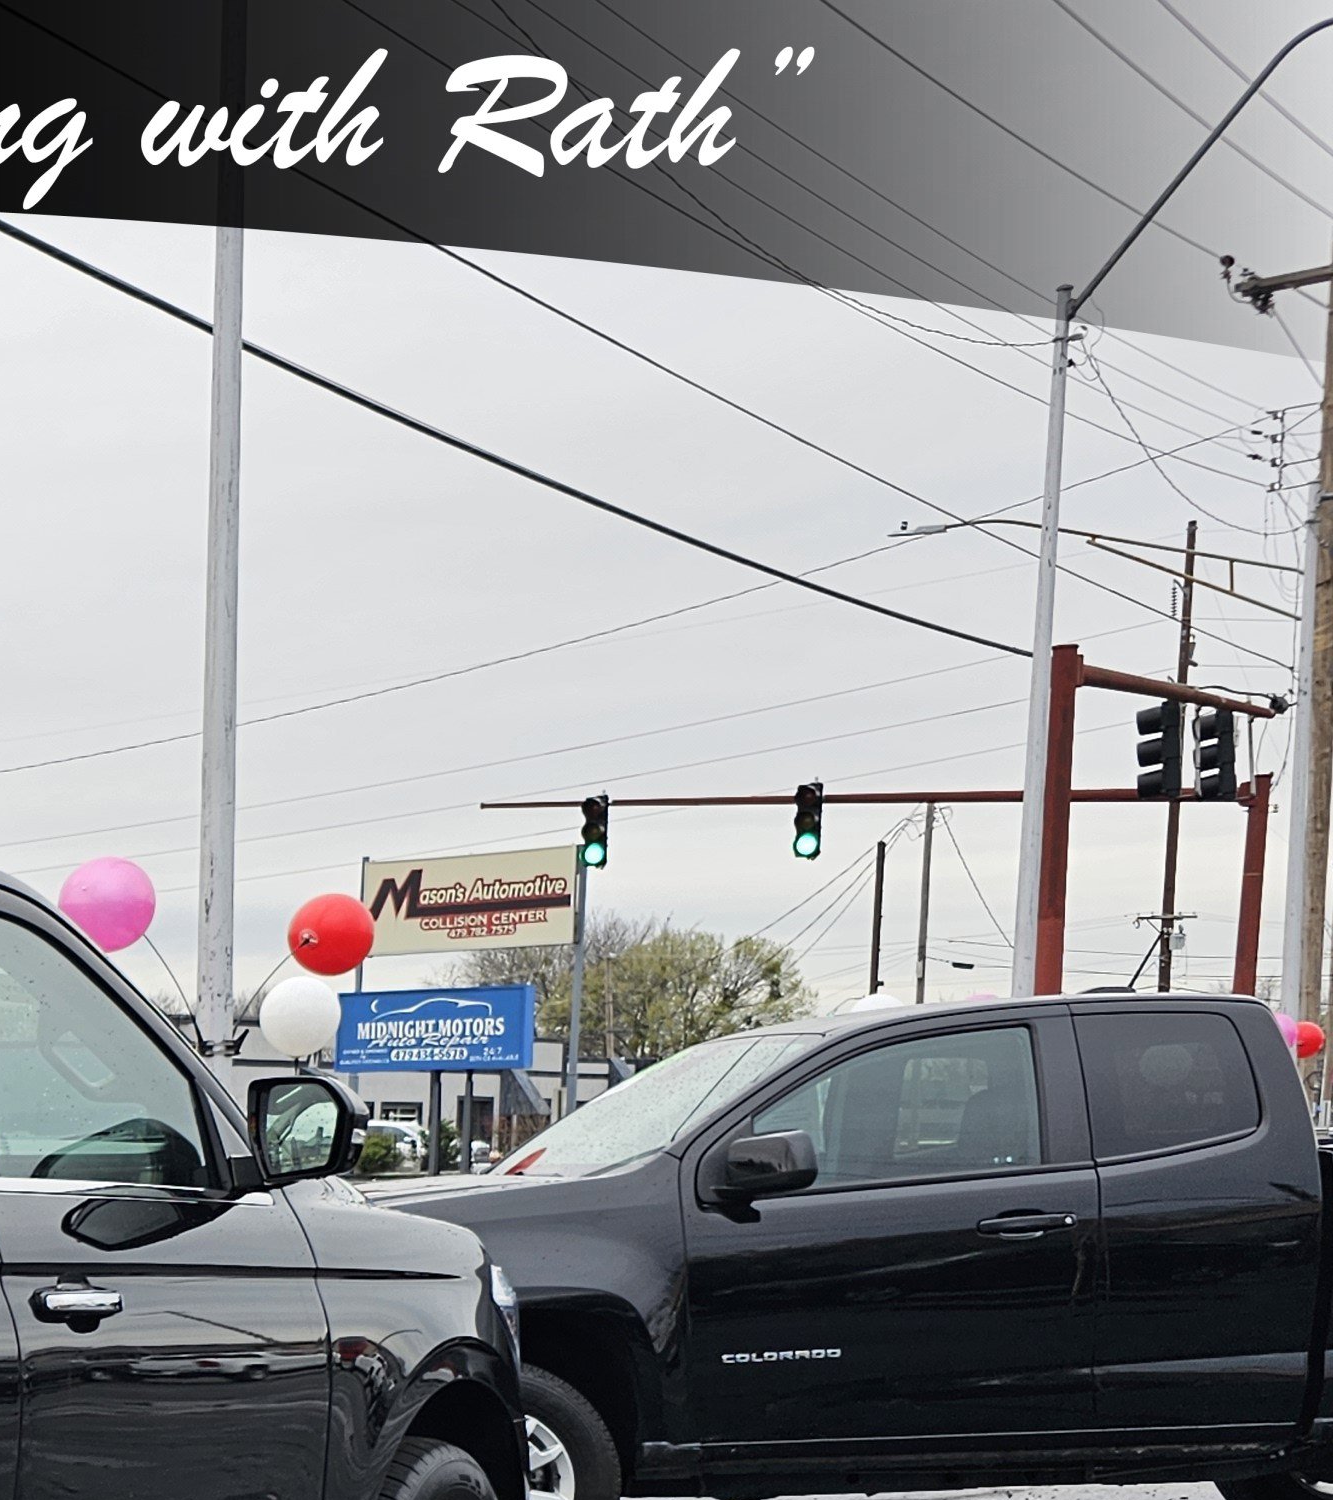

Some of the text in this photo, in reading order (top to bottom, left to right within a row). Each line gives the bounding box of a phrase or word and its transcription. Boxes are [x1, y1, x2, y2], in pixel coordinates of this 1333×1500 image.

[466, 875, 567, 902] Automotive
[421, 910, 547, 930] COLLISION CENTER
[357, 1017, 505, 1040] MIDNIGHT MOTORS
[367, 1032, 490, 1052] Auto Repair
[721, 1348, 842, 1364] COLORADO
